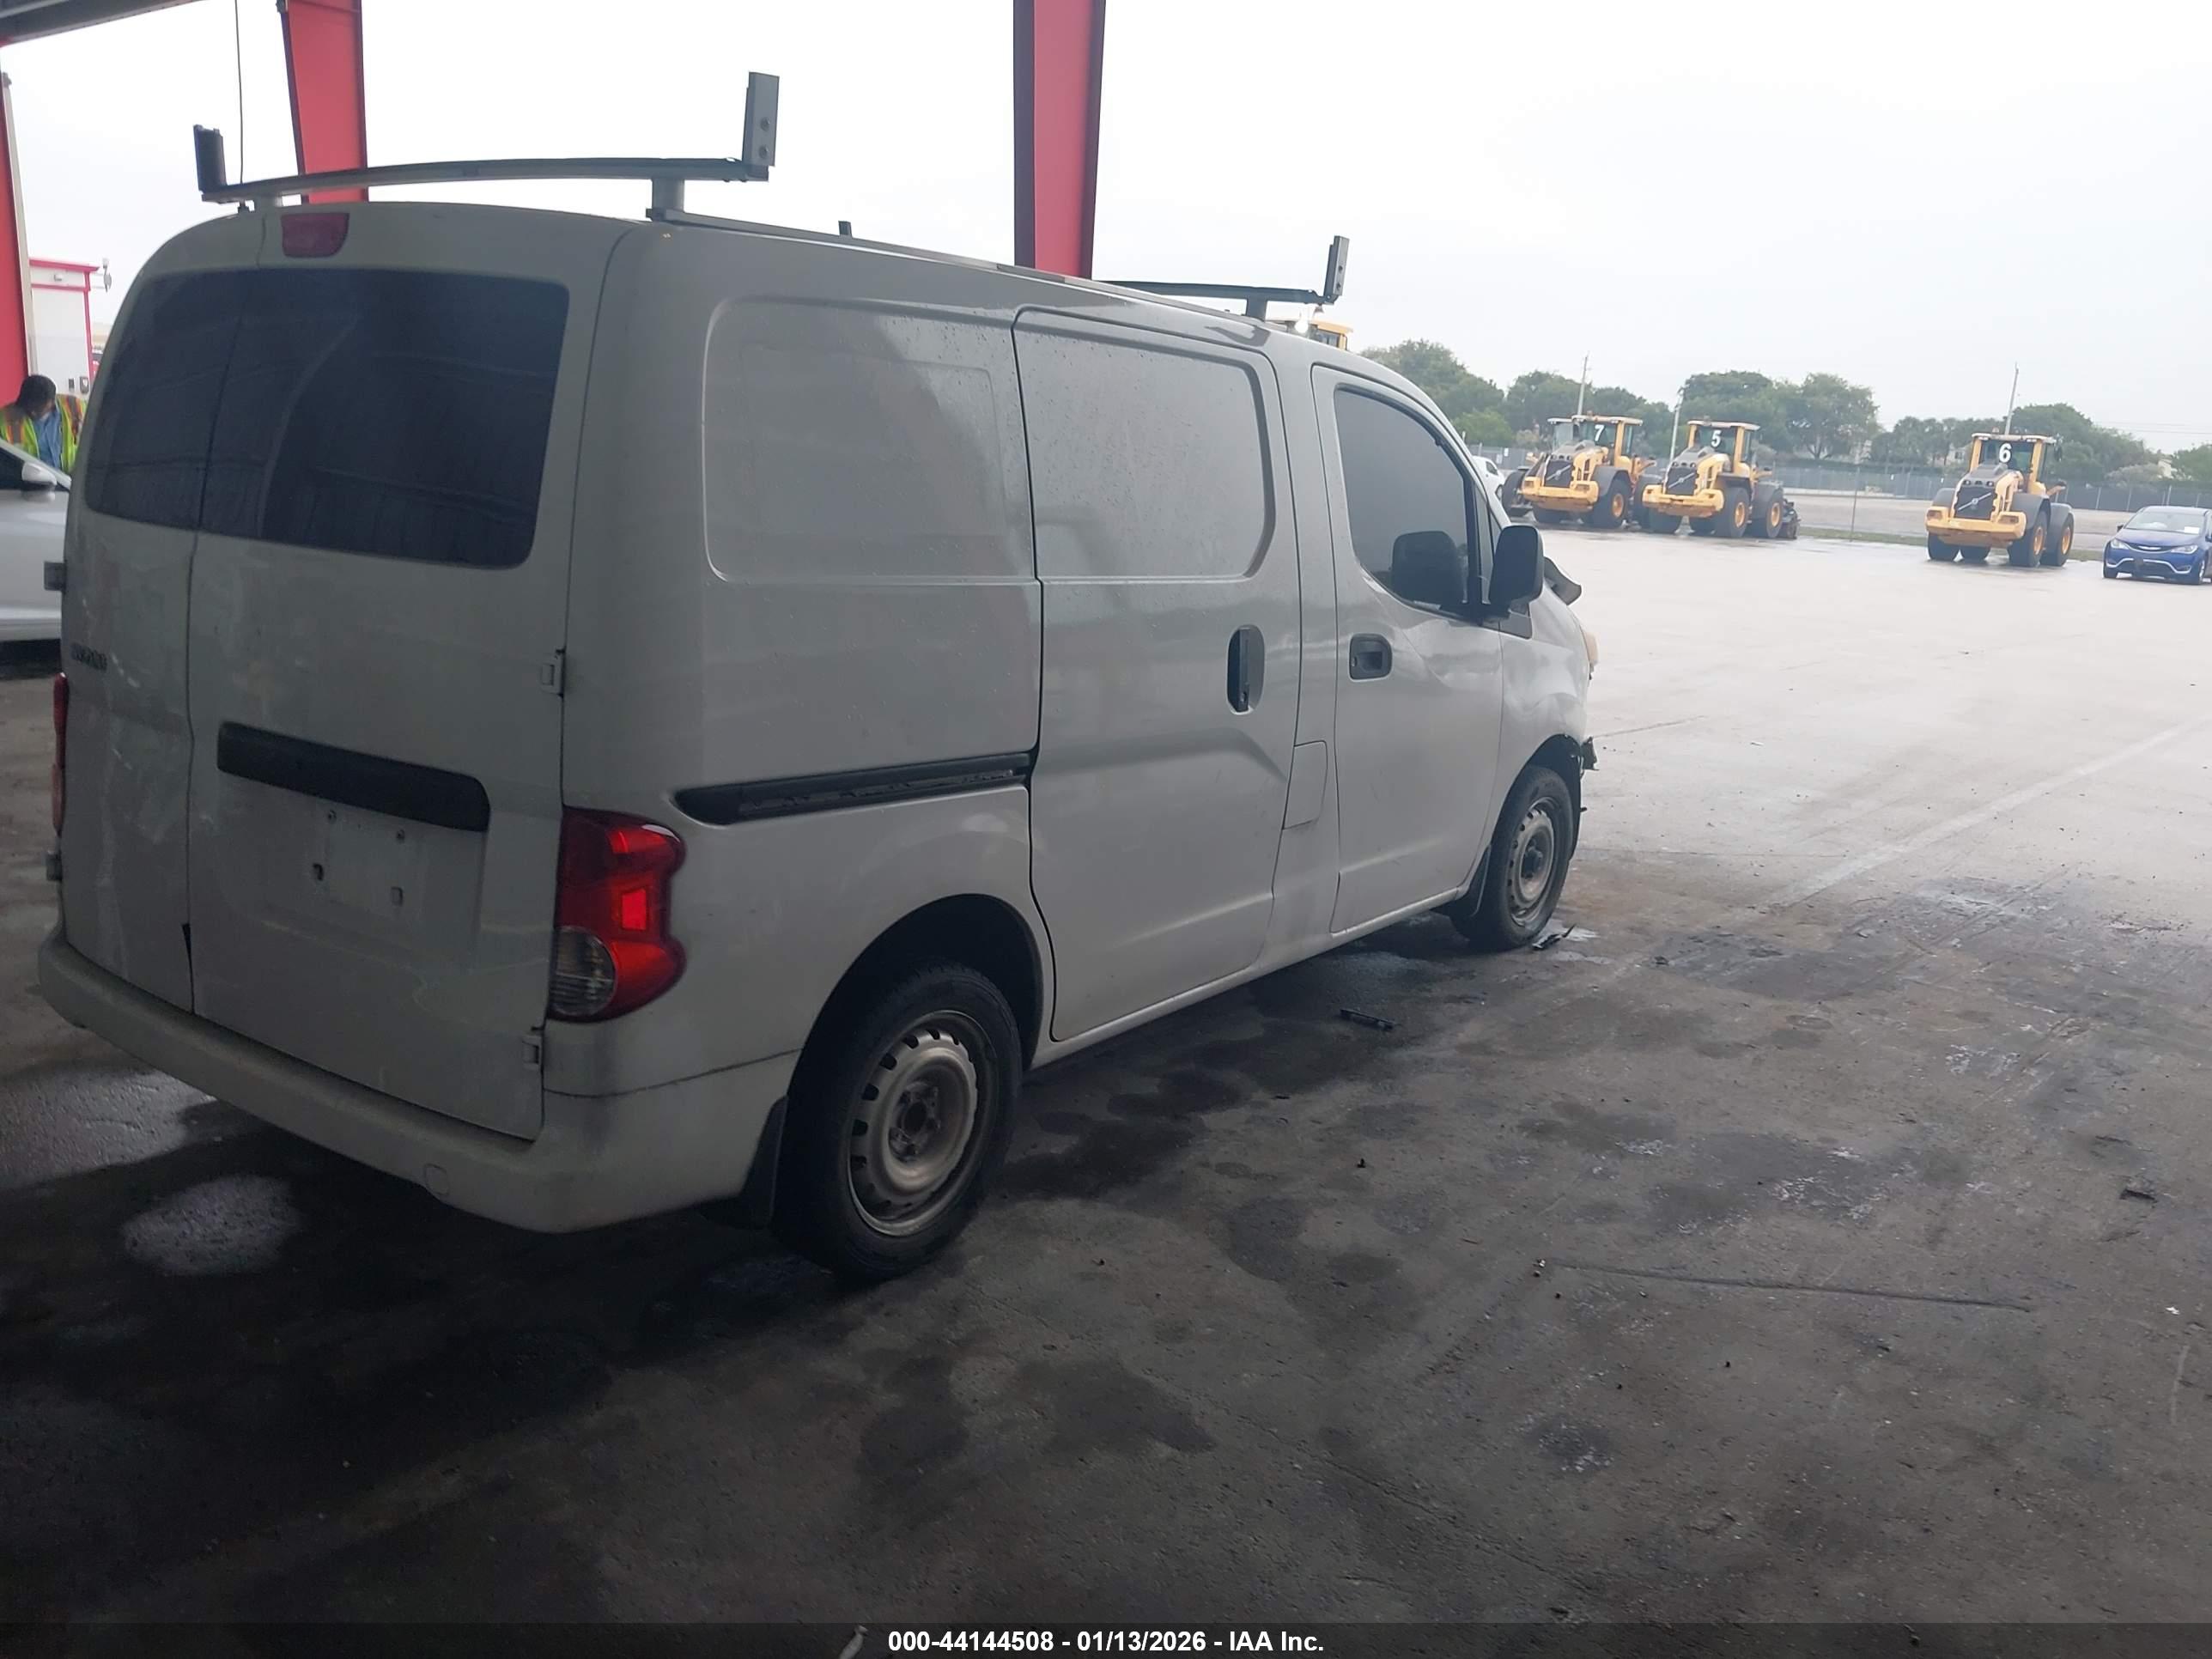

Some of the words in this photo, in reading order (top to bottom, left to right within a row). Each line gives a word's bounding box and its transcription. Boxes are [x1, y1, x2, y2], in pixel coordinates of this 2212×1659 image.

[1594, 424, 1605, 441] 7
[1711, 429, 1722, 447] 5
[1999, 442, 2012, 463] 6
